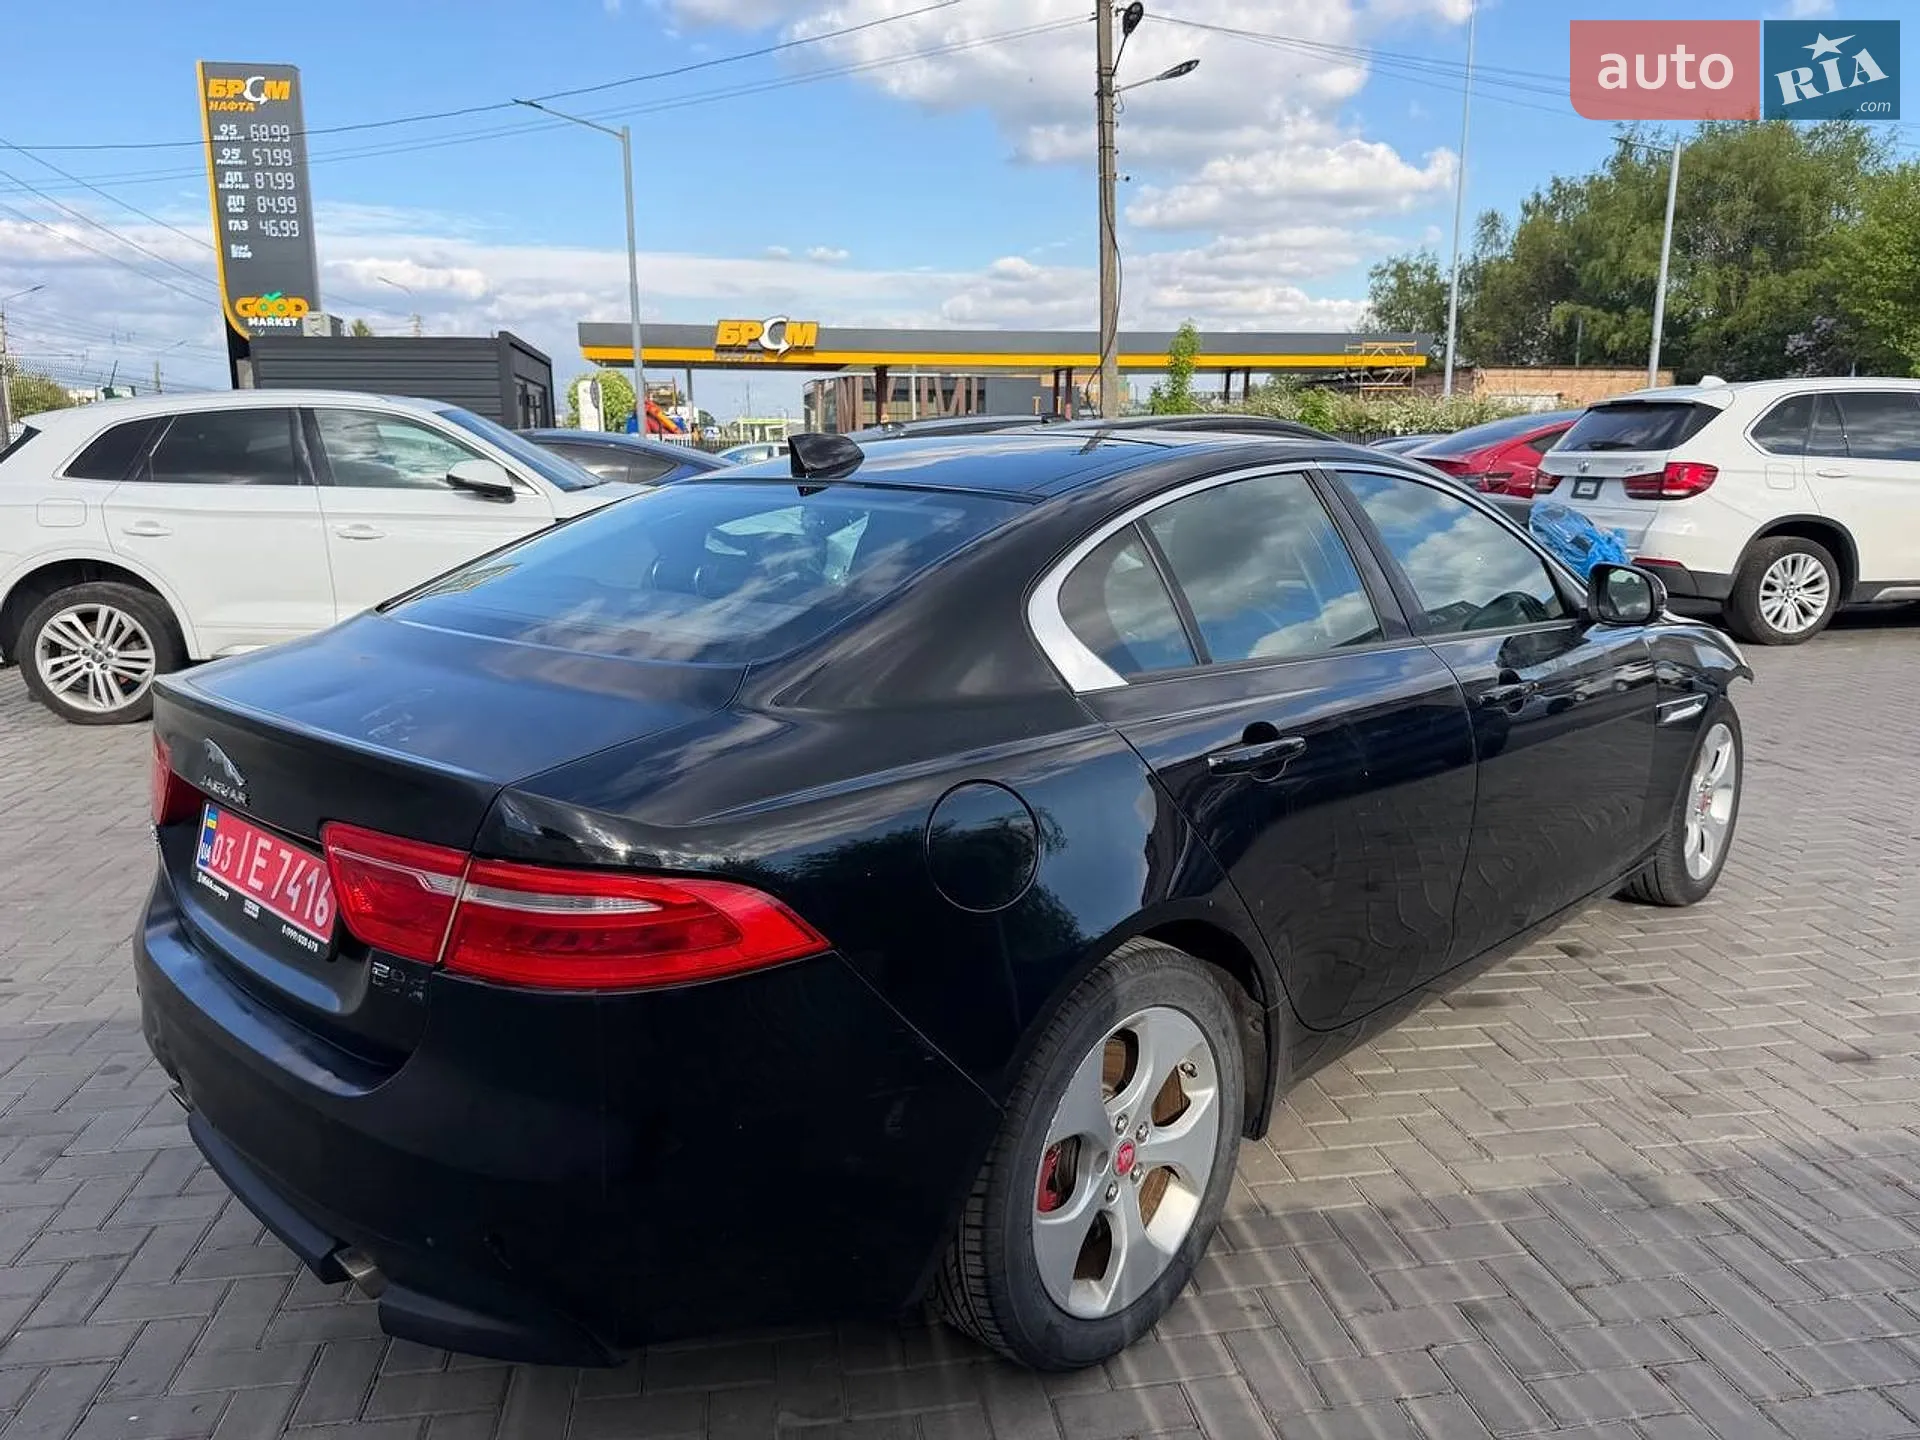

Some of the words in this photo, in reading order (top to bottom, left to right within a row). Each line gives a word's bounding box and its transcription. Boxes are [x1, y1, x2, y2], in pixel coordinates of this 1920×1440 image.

[207, 76, 291, 104] БРСМ
[208, 101, 256, 112] НАФТА
[219, 124, 238, 136] 95
[250, 124, 290, 142] 68.99
[221, 147, 241, 160] 95
[252, 148, 292, 166] 57.99
[224, 171, 243, 183] ДП
[254, 172, 295, 190] 87.99
[227, 195, 245, 207] ДП
[257, 196, 297, 214] 84.99
[228, 220, 249, 231] ГАЗ
[260, 220, 299, 237] 46.99
[235, 296, 309, 318] GOOD
[247, 317, 299, 327] MARKET
[716, 316, 818, 357] БРСМ
